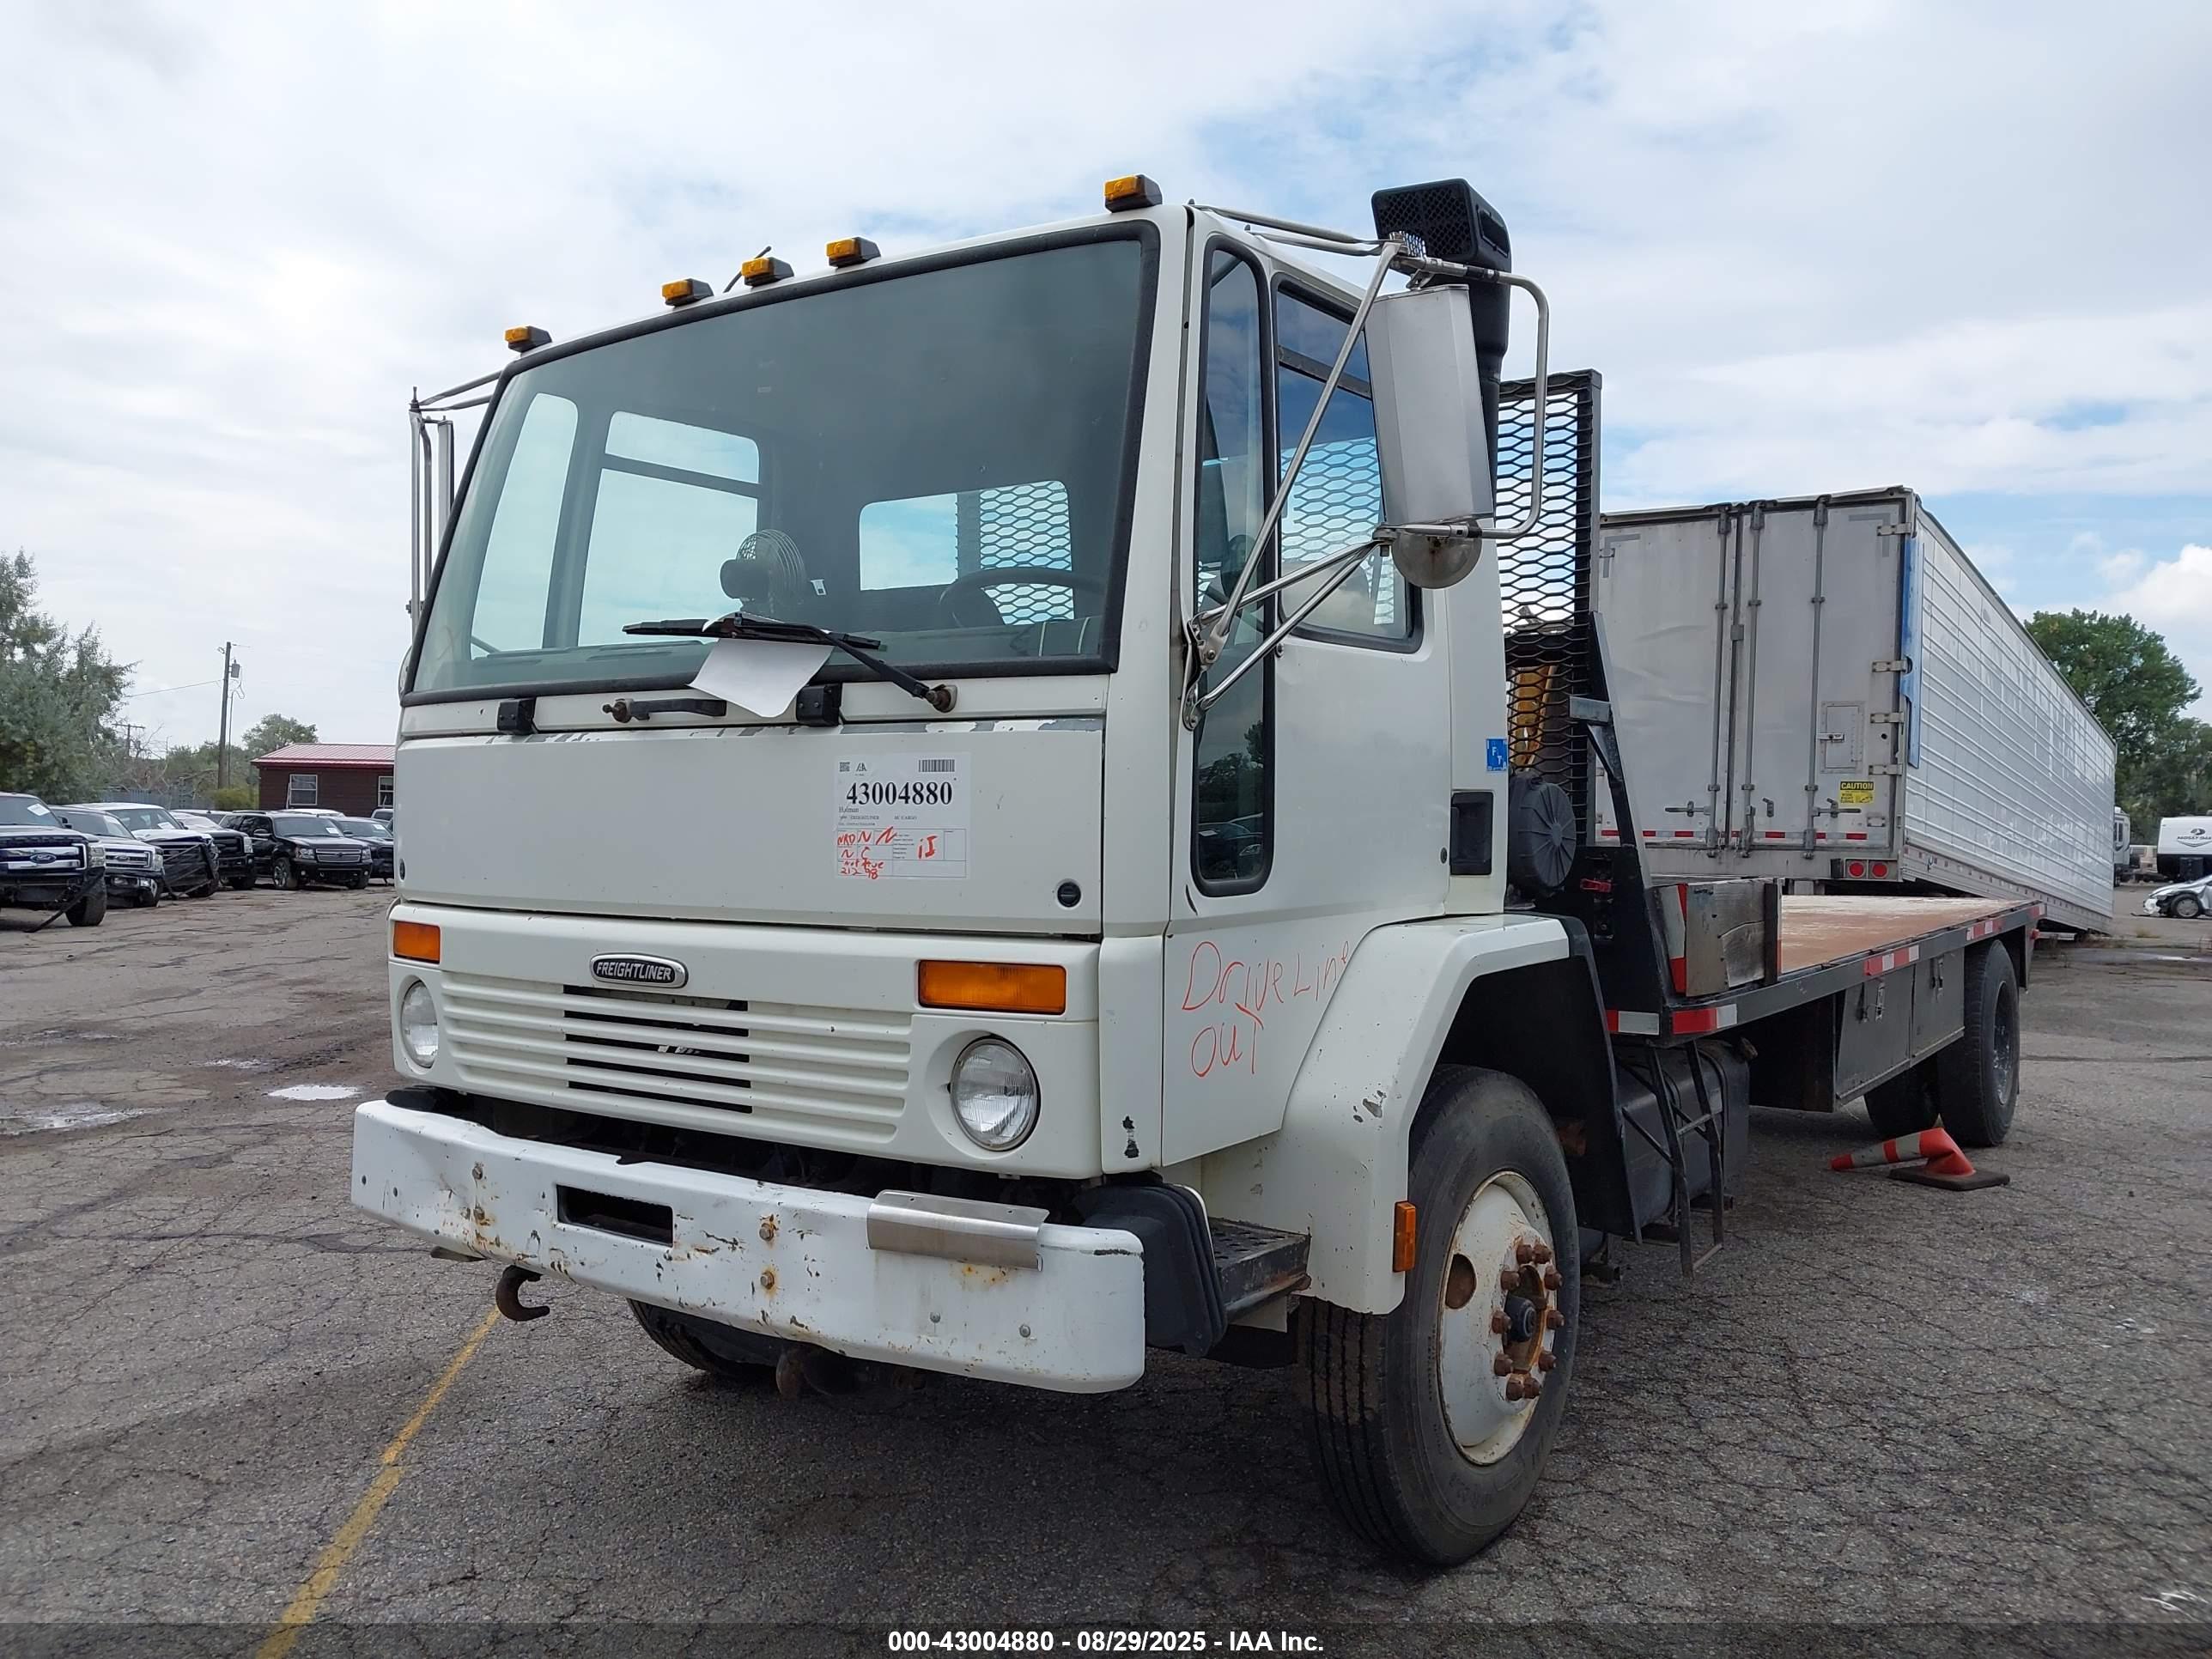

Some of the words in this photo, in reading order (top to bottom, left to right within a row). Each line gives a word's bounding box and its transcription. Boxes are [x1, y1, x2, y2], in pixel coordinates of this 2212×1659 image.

[846, 781, 953, 805] 43004880
[596, 962, 672, 981] FREIGHTLINER
[1182, 941, 1285, 1011] Drive
